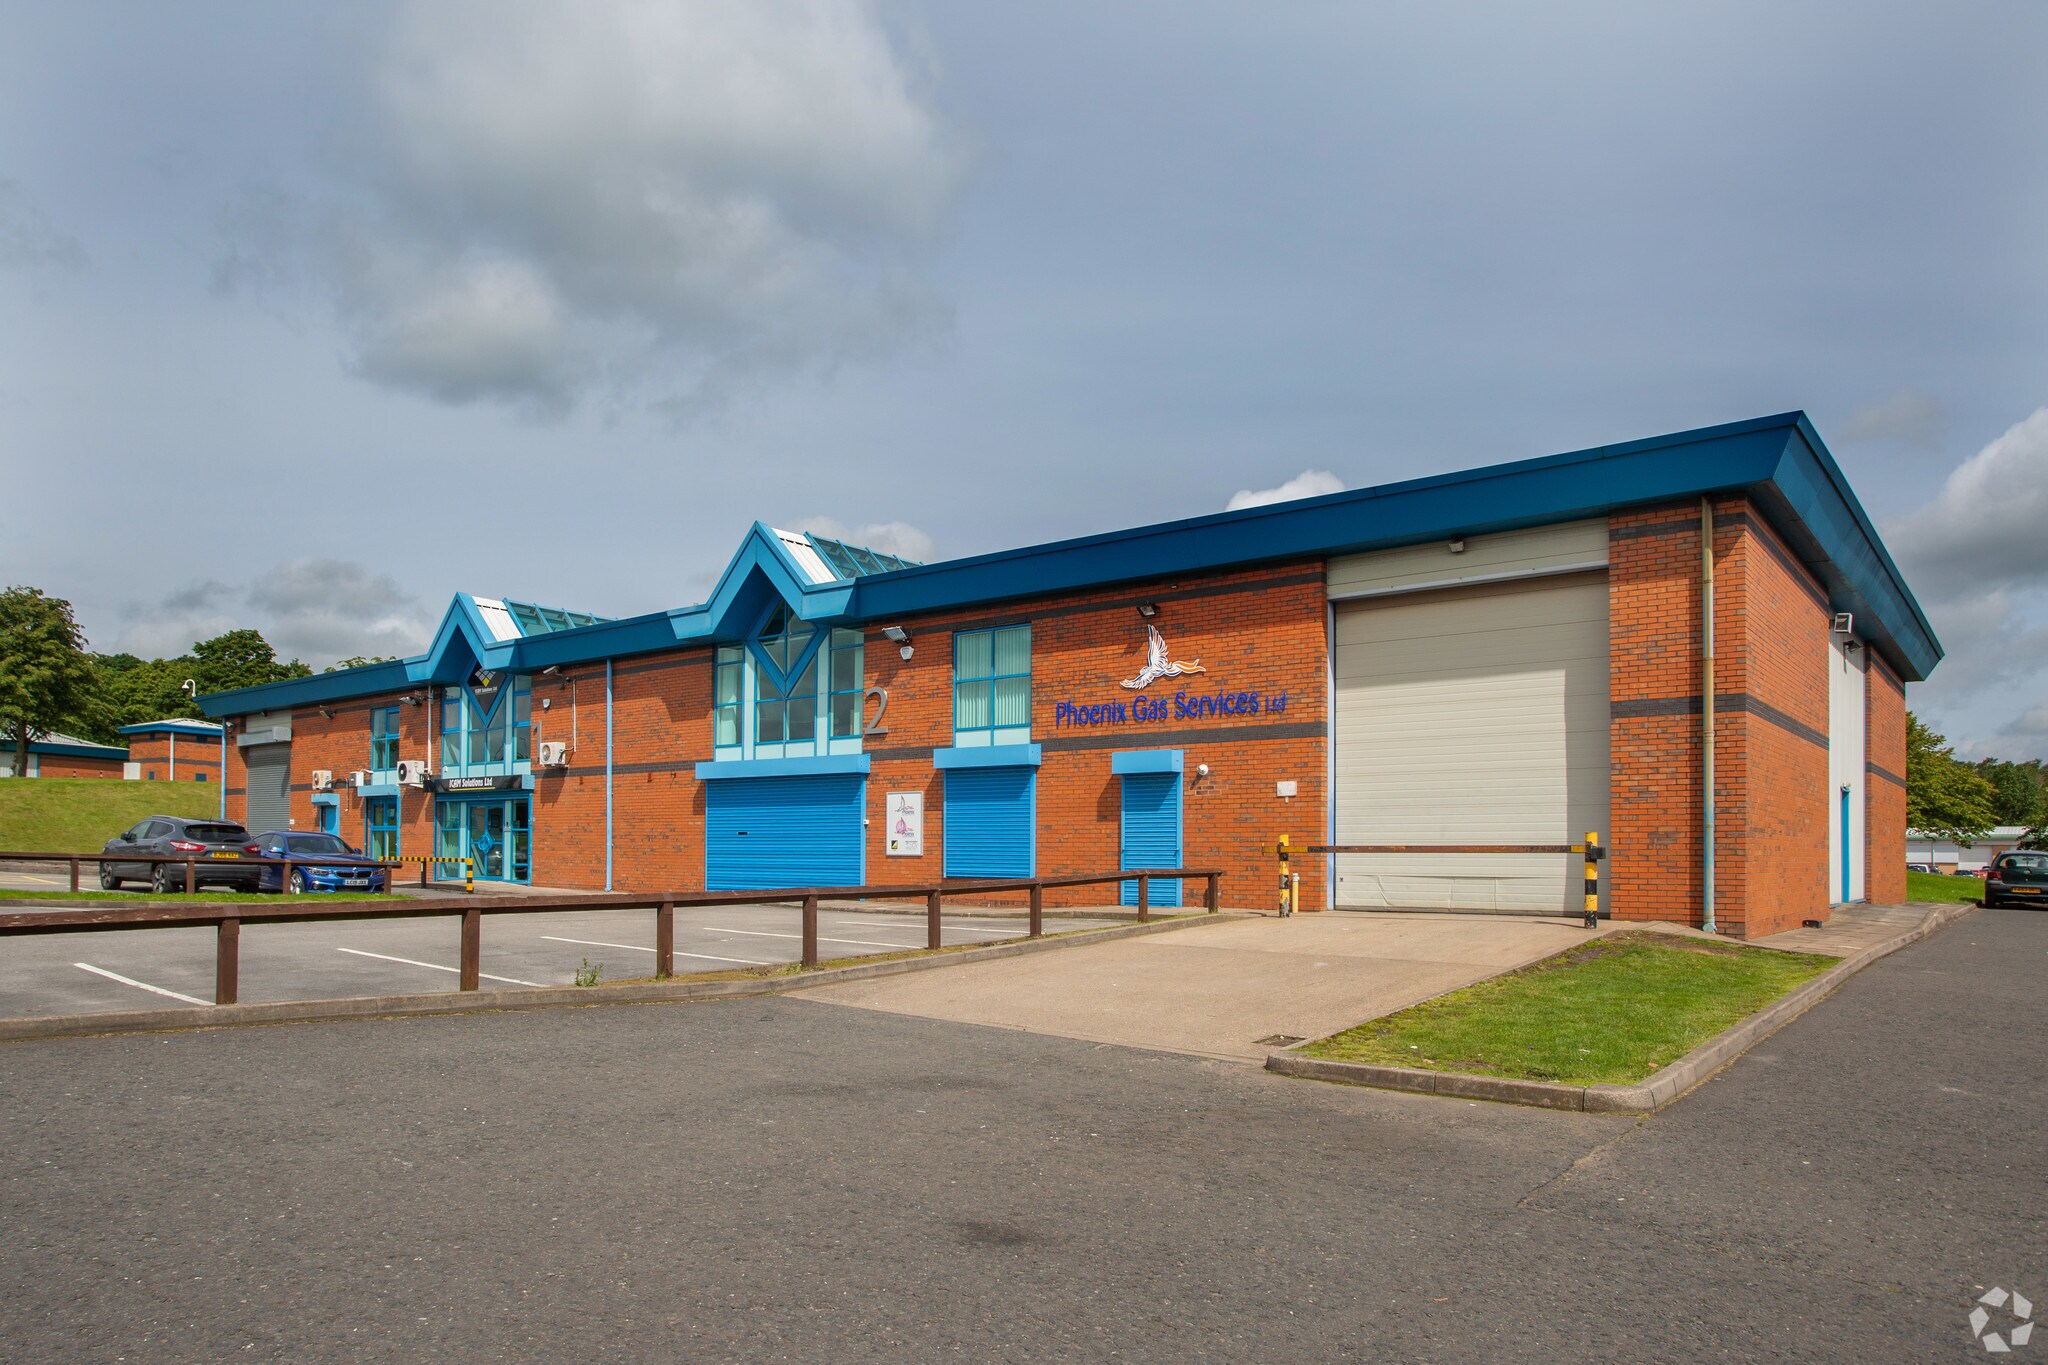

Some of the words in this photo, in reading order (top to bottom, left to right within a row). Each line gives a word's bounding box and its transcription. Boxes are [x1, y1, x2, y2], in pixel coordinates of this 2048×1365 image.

[865, 686, 888, 734] 2
[1055, 698, 1127, 727] Phoenix
[1133, 695, 1168, 721] Gas
[1175, 689, 1260, 718] Services
[1266, 692, 1287, 711] Ltd
[462, 778, 483, 787] Solutions
[484, 777, 493, 786] Ltd
